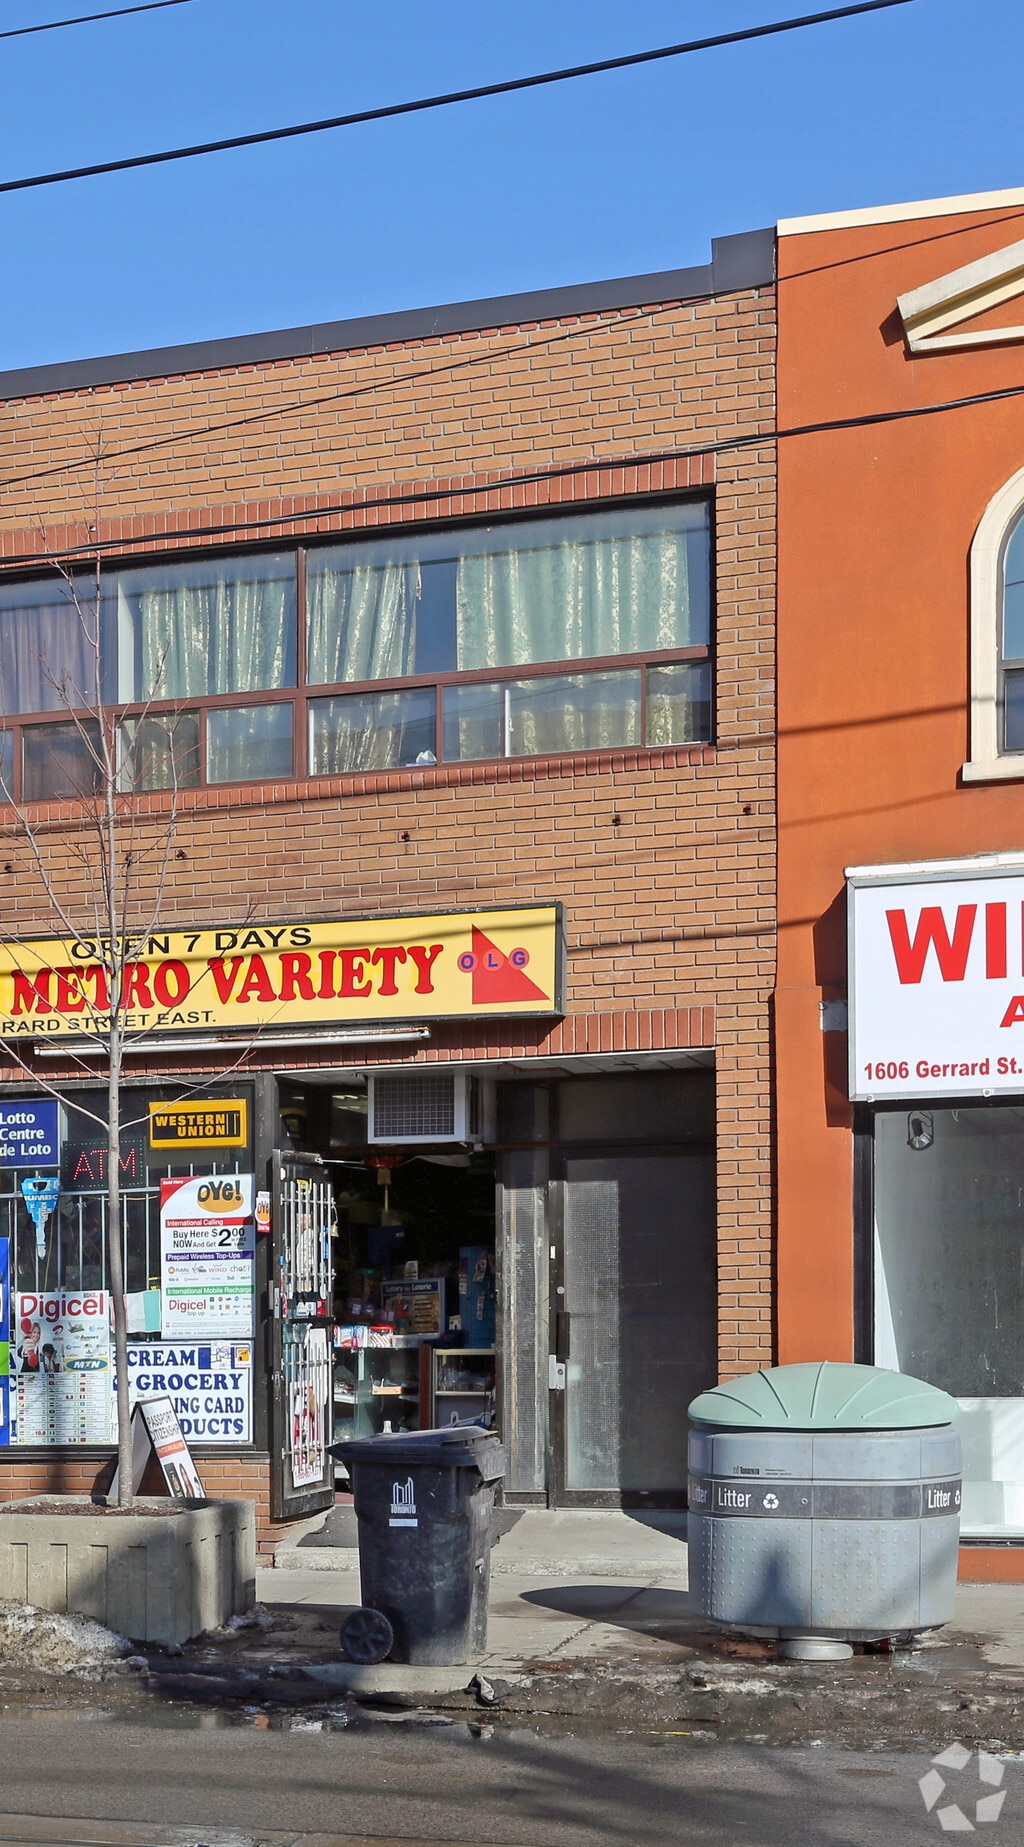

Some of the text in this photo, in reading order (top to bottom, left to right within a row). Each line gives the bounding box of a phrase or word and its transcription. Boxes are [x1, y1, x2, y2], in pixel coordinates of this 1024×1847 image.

[71, 927, 312, 959] OPEN 7 DAYS
[885, 900, 1024, 985] WI
[10, 957, 191, 1017] METRO
[207, 944, 444, 1005] VARIETY
[67, 1014, 150, 1030] STREET
[157, 1010, 217, 1025] EAST.
[864, 1056, 1024, 1081] 1606 Gerrard St.
[155, 1113, 225, 1127] WESTERN
[177, 1125, 225, 1137] UNION
[0, 1143, 51, 1156] de Loto
[73, 1148, 136, 1181] ATM
[173, 1230, 188, 1239] Buy
[189, 1229, 209, 1238] Here
[173, 1240, 193, 1248] NOW
[167, 1253, 189, 1261] Prepaid
[190, 1252, 215, 1260] Wireless
[411, 1283, 432, 1291] Loterie
[20, 1293, 104, 1323] Digicel
[169, 1299, 206, 1313] Digicel
[73, 1360, 101, 1369] MTN
[127, 1347, 195, 1367] CREAM
[136, 1374, 244, 1391] GROCERY
[204, 1396, 244, 1414] CARD
[146, 1411, 174, 1429] PASSPORT
[179, 1418, 244, 1436] DUCTS
[718, 1487, 752, 1509] Litter
[928, 1489, 951, 1509] Litter
